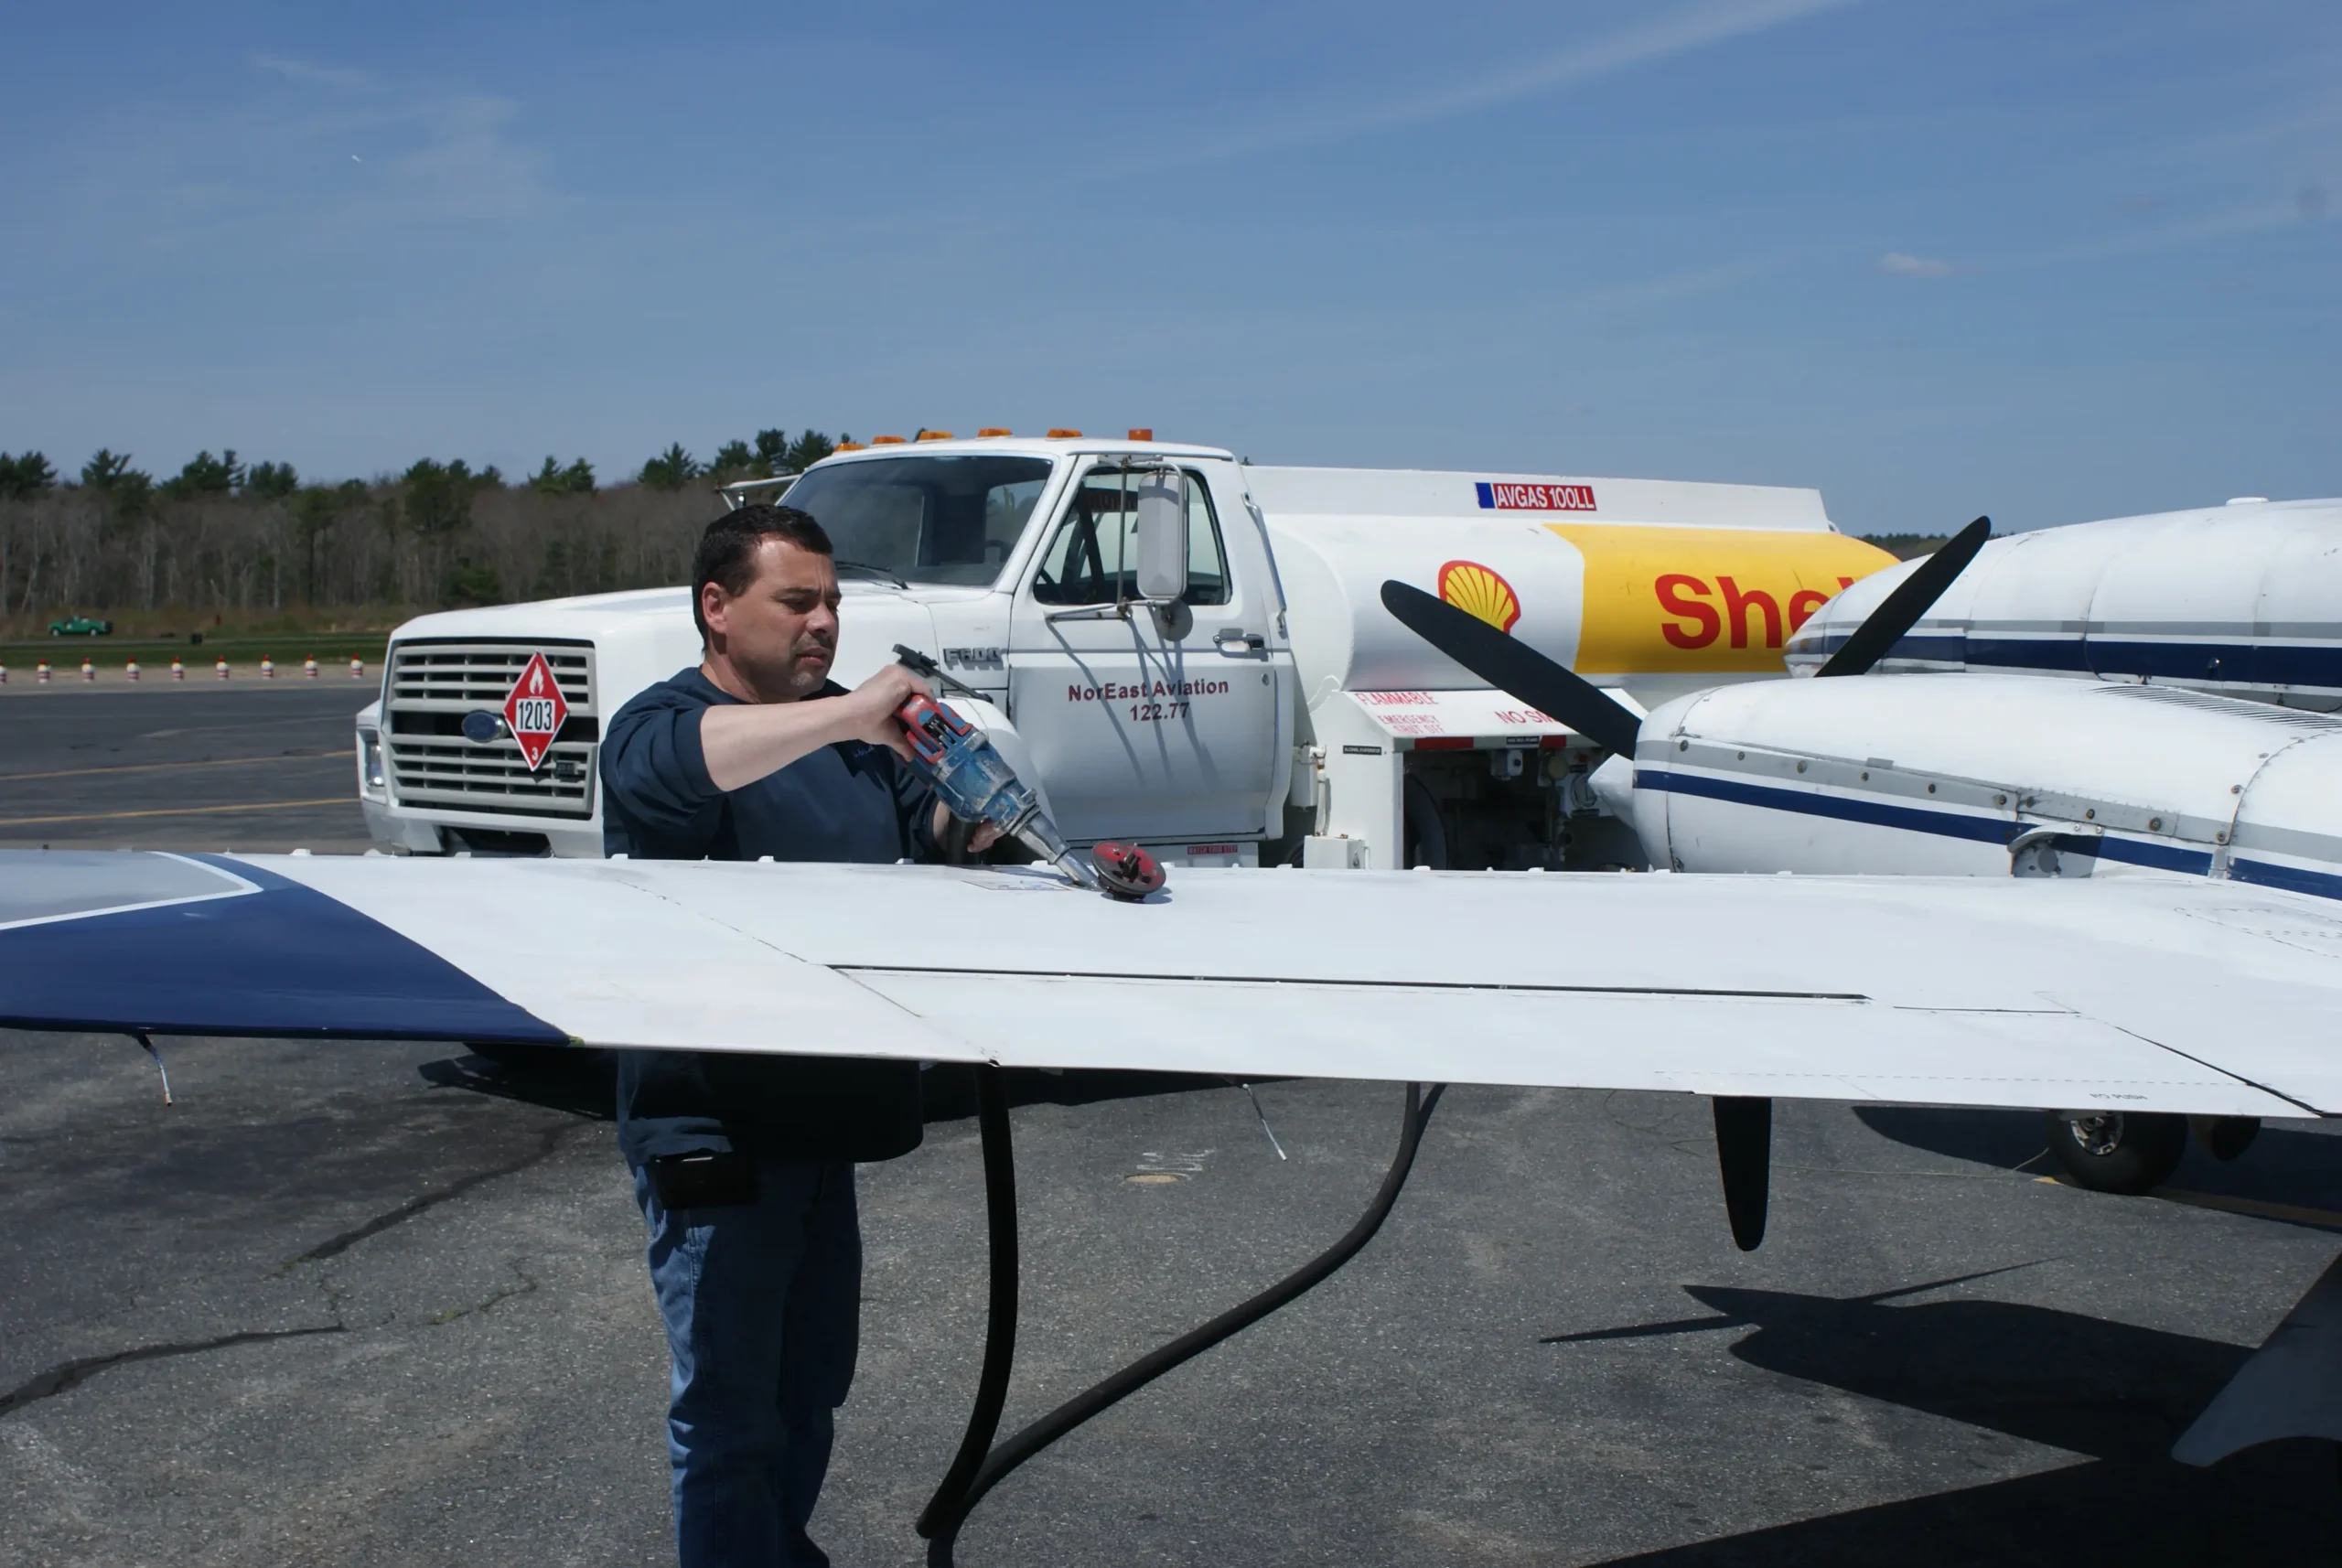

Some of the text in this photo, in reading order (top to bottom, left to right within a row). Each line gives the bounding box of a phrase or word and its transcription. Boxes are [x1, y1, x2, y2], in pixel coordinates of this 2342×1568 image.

[1497, 485, 1595, 509] AVGAS 100LL
[1655, 574, 1854, 649] She
[1068, 678, 1230, 702] NorEast Aviation
[1355, 692, 1439, 705] FLAMMABLE
[518, 701, 553, 731] 1203
[1129, 702, 1190, 722] 122.77
[1494, 710, 1526, 724] NO
[532, 746, 539, 761] 3
